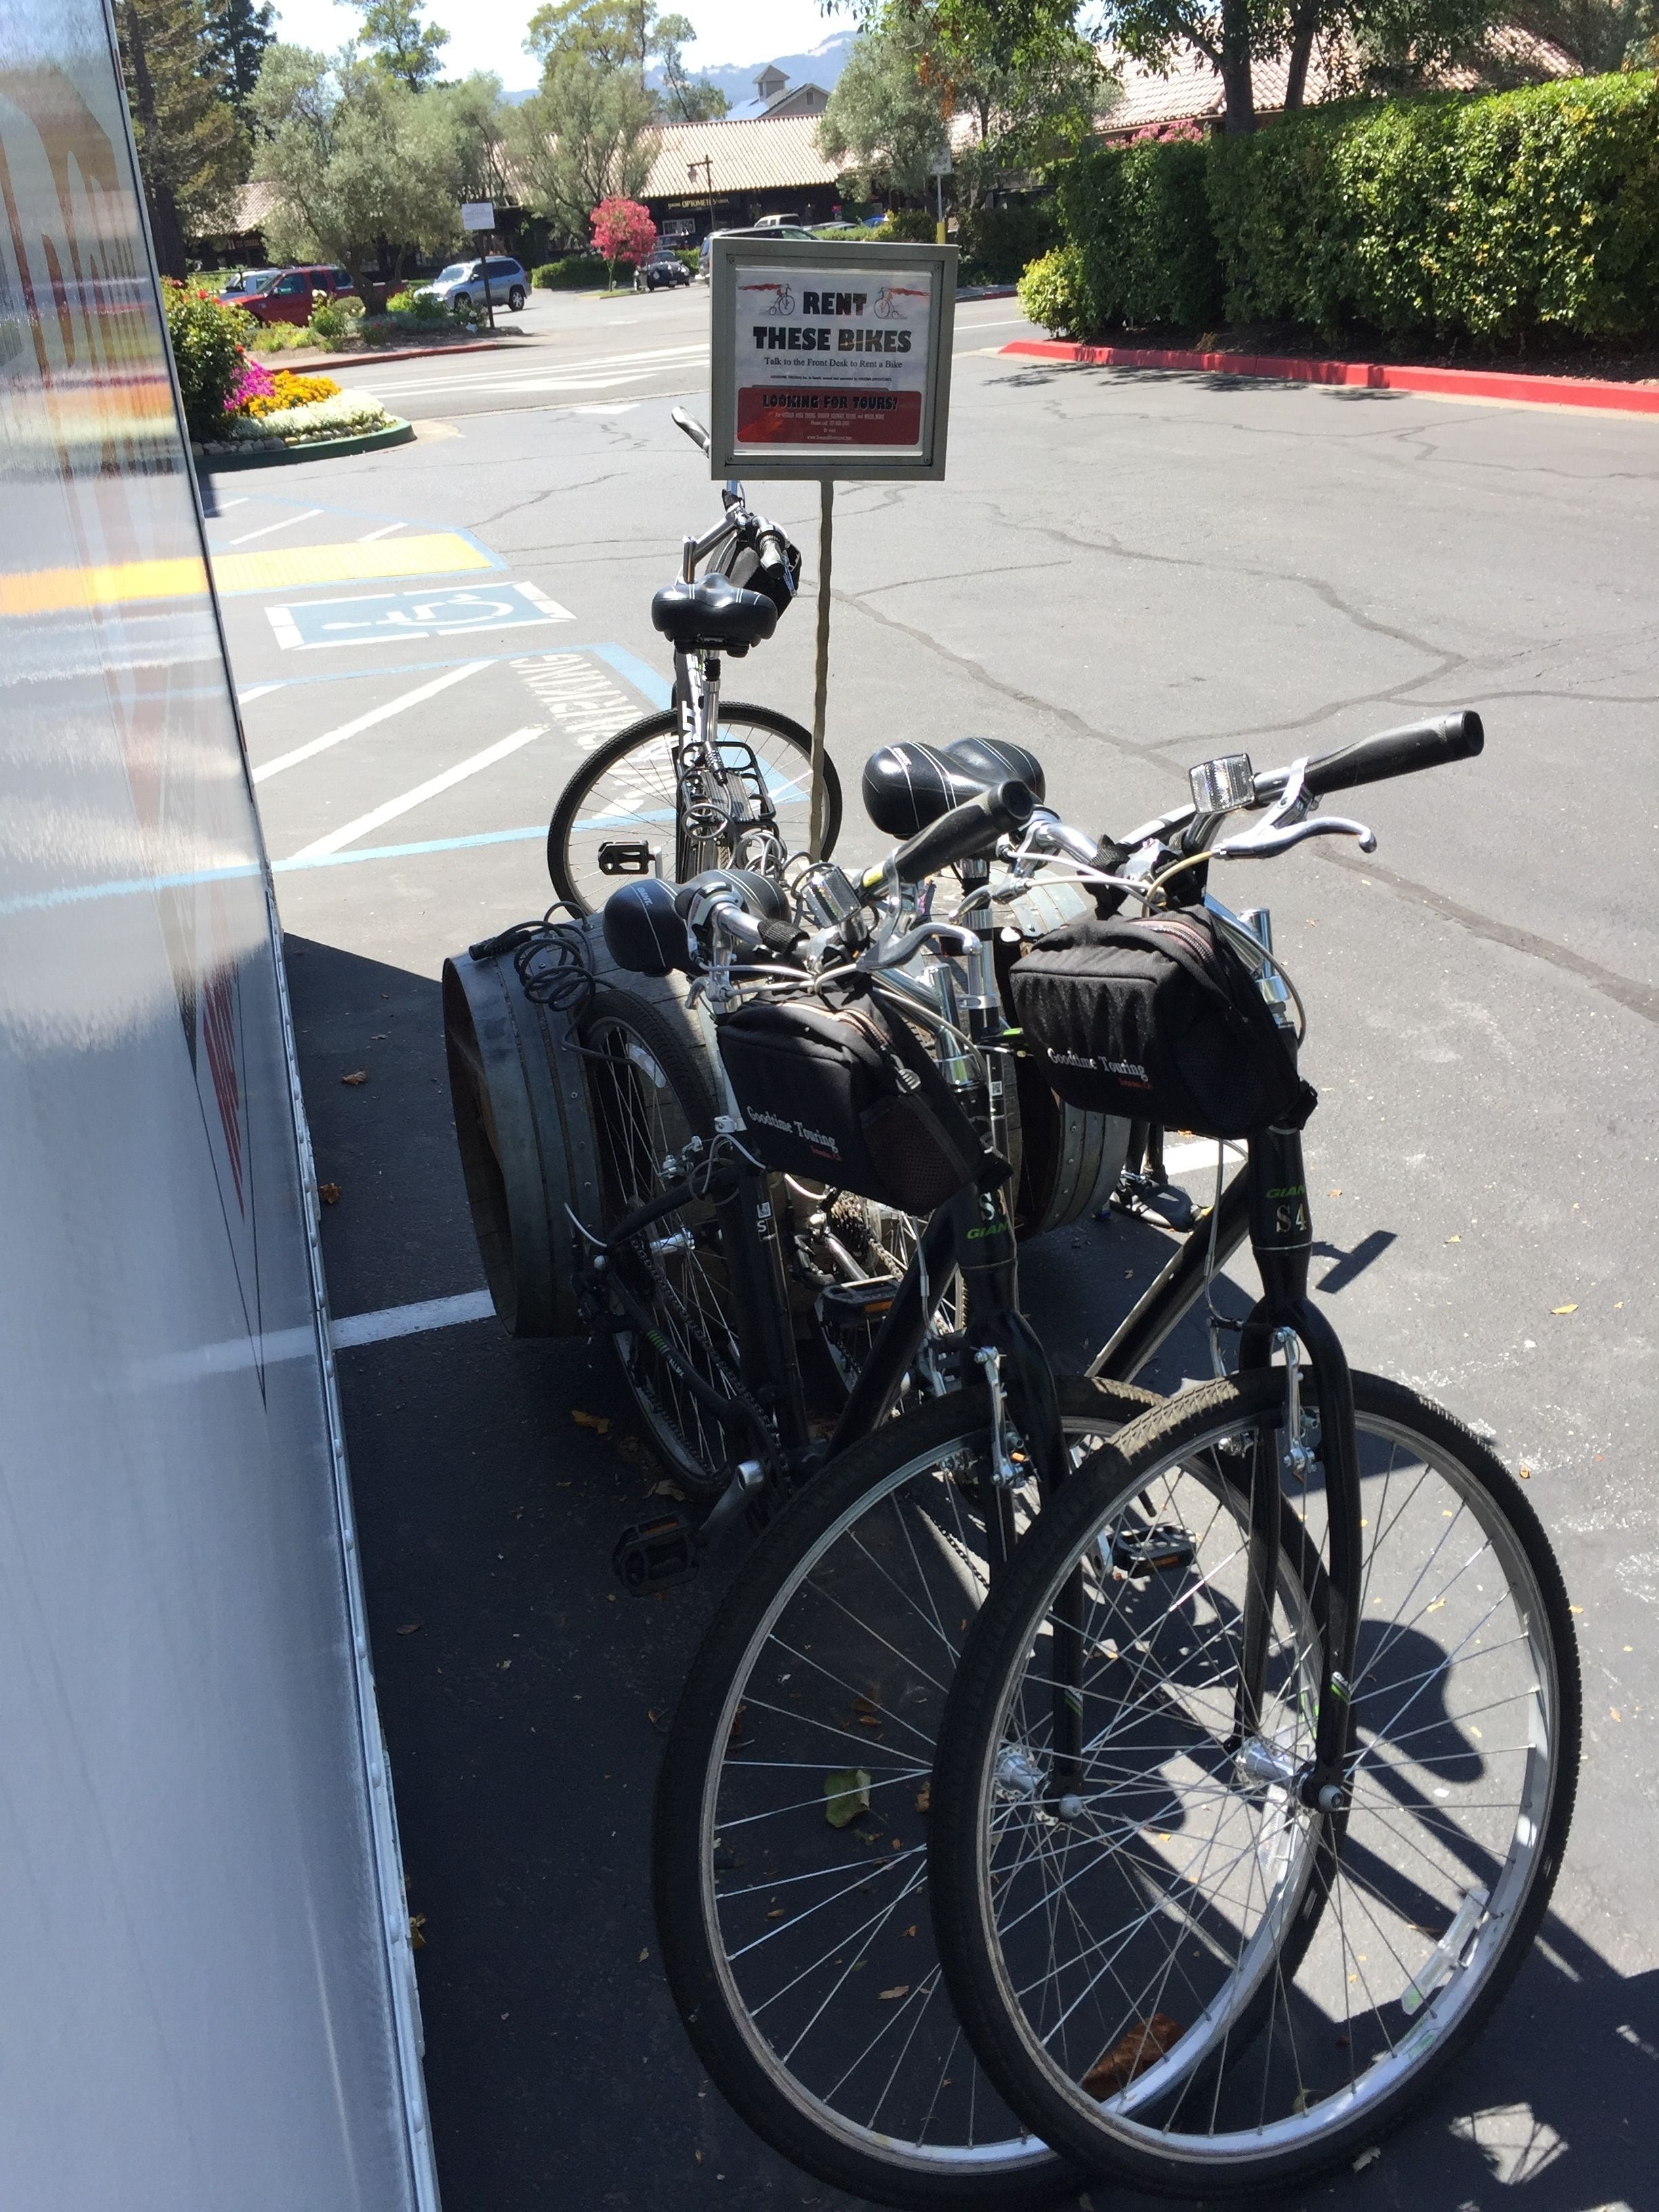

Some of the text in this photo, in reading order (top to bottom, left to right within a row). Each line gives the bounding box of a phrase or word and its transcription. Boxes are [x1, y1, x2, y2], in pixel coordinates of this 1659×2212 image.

[803, 291, 867, 316] RENT
[753, 327, 912, 353] THESE BIKES
[764, 357, 782, 366] Talk
[794, 358, 805, 366] the
[807, 359, 827, 367] Front
[830, 359, 848, 367] Desk
[885, 361, 903, 369] Bike
[762, 394, 819, 410] LOOKING
[823, 395, 848, 410] FOR
[1047, 1048, 1149, 1082] Goodtime Touring
[747, 1105, 793, 1134] Goodtime
[794, 1120, 839, 1153] Touring
[1266, 1185, 1306, 1199] GIAN
[966, 1221, 1009, 1240] GIAN
